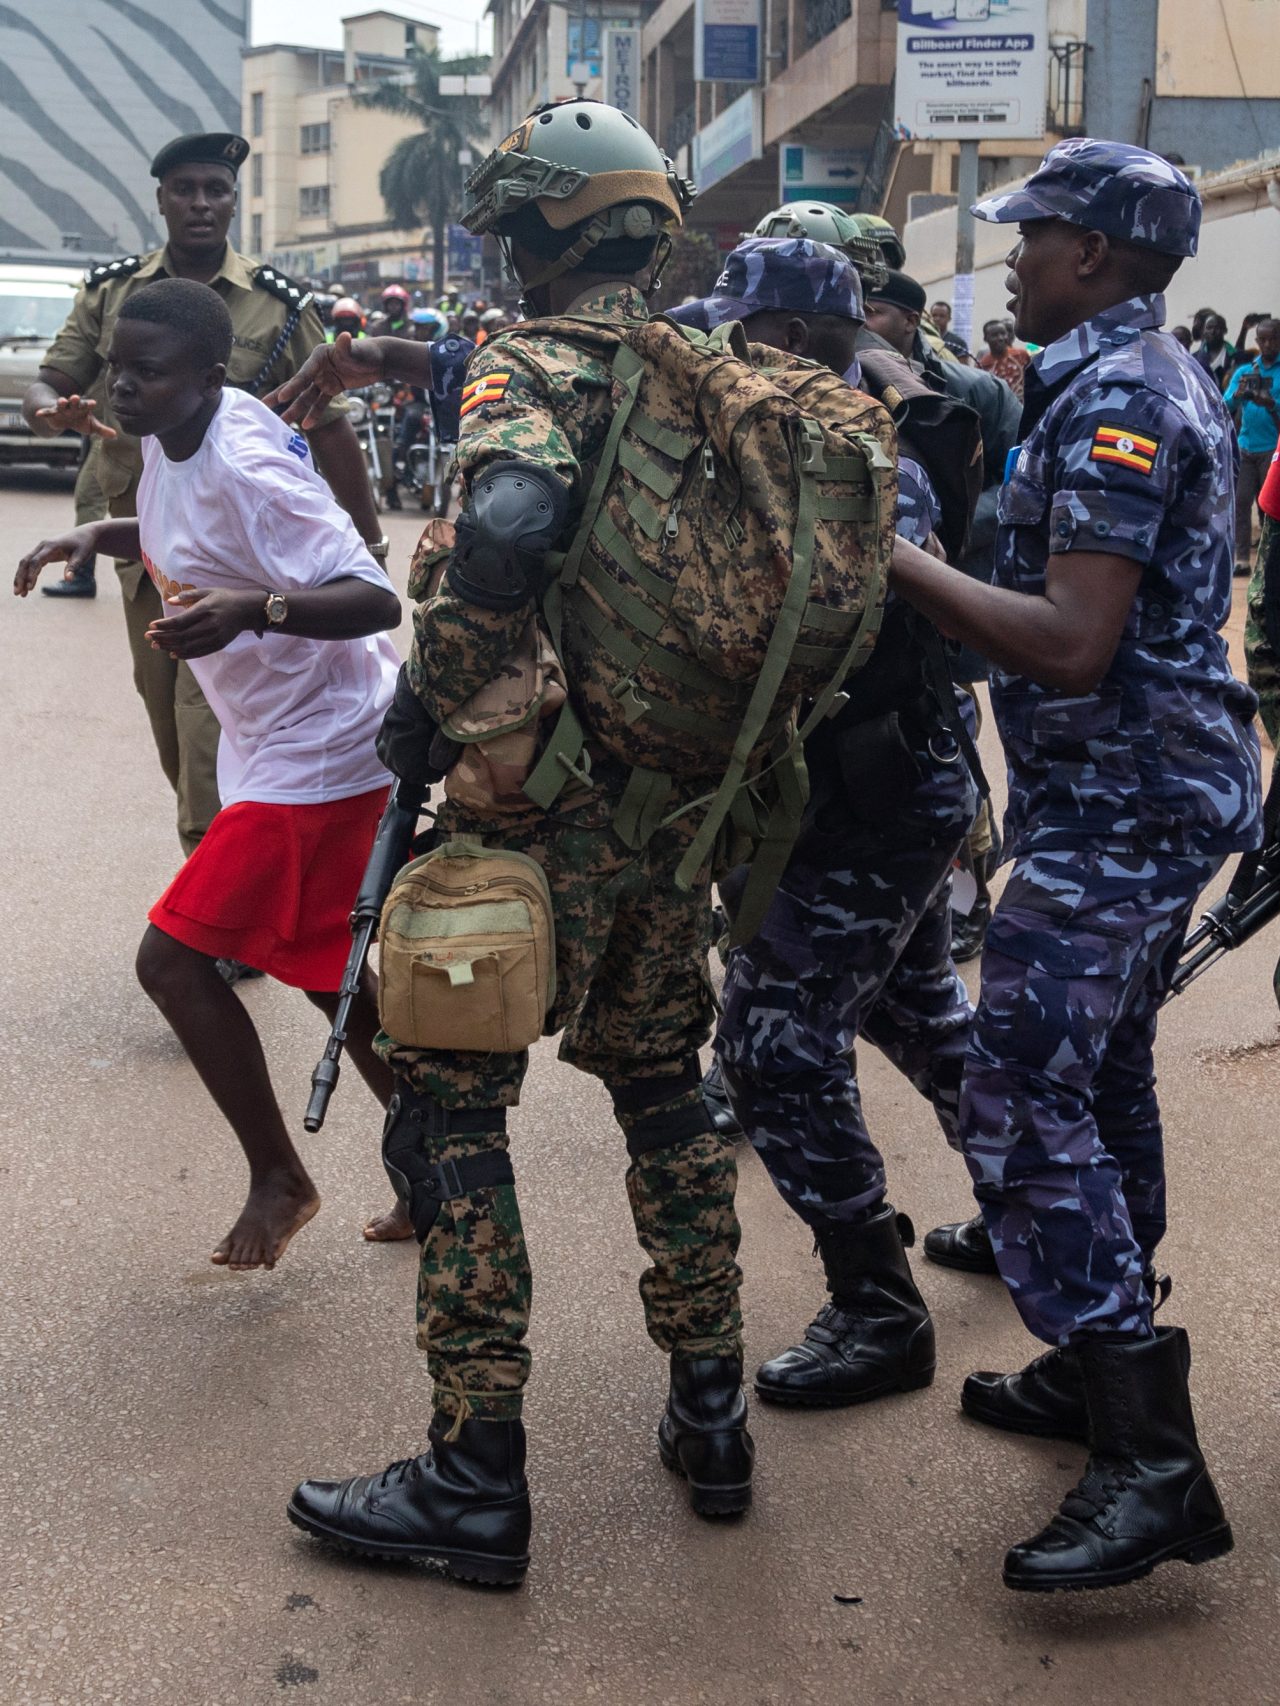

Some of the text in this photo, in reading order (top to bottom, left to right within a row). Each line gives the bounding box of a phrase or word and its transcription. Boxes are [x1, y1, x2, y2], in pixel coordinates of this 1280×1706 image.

[912, 37, 1029, 50] Billboard Finder App
[996, 59, 1021, 68] easily
[978, 69, 994, 77] and
